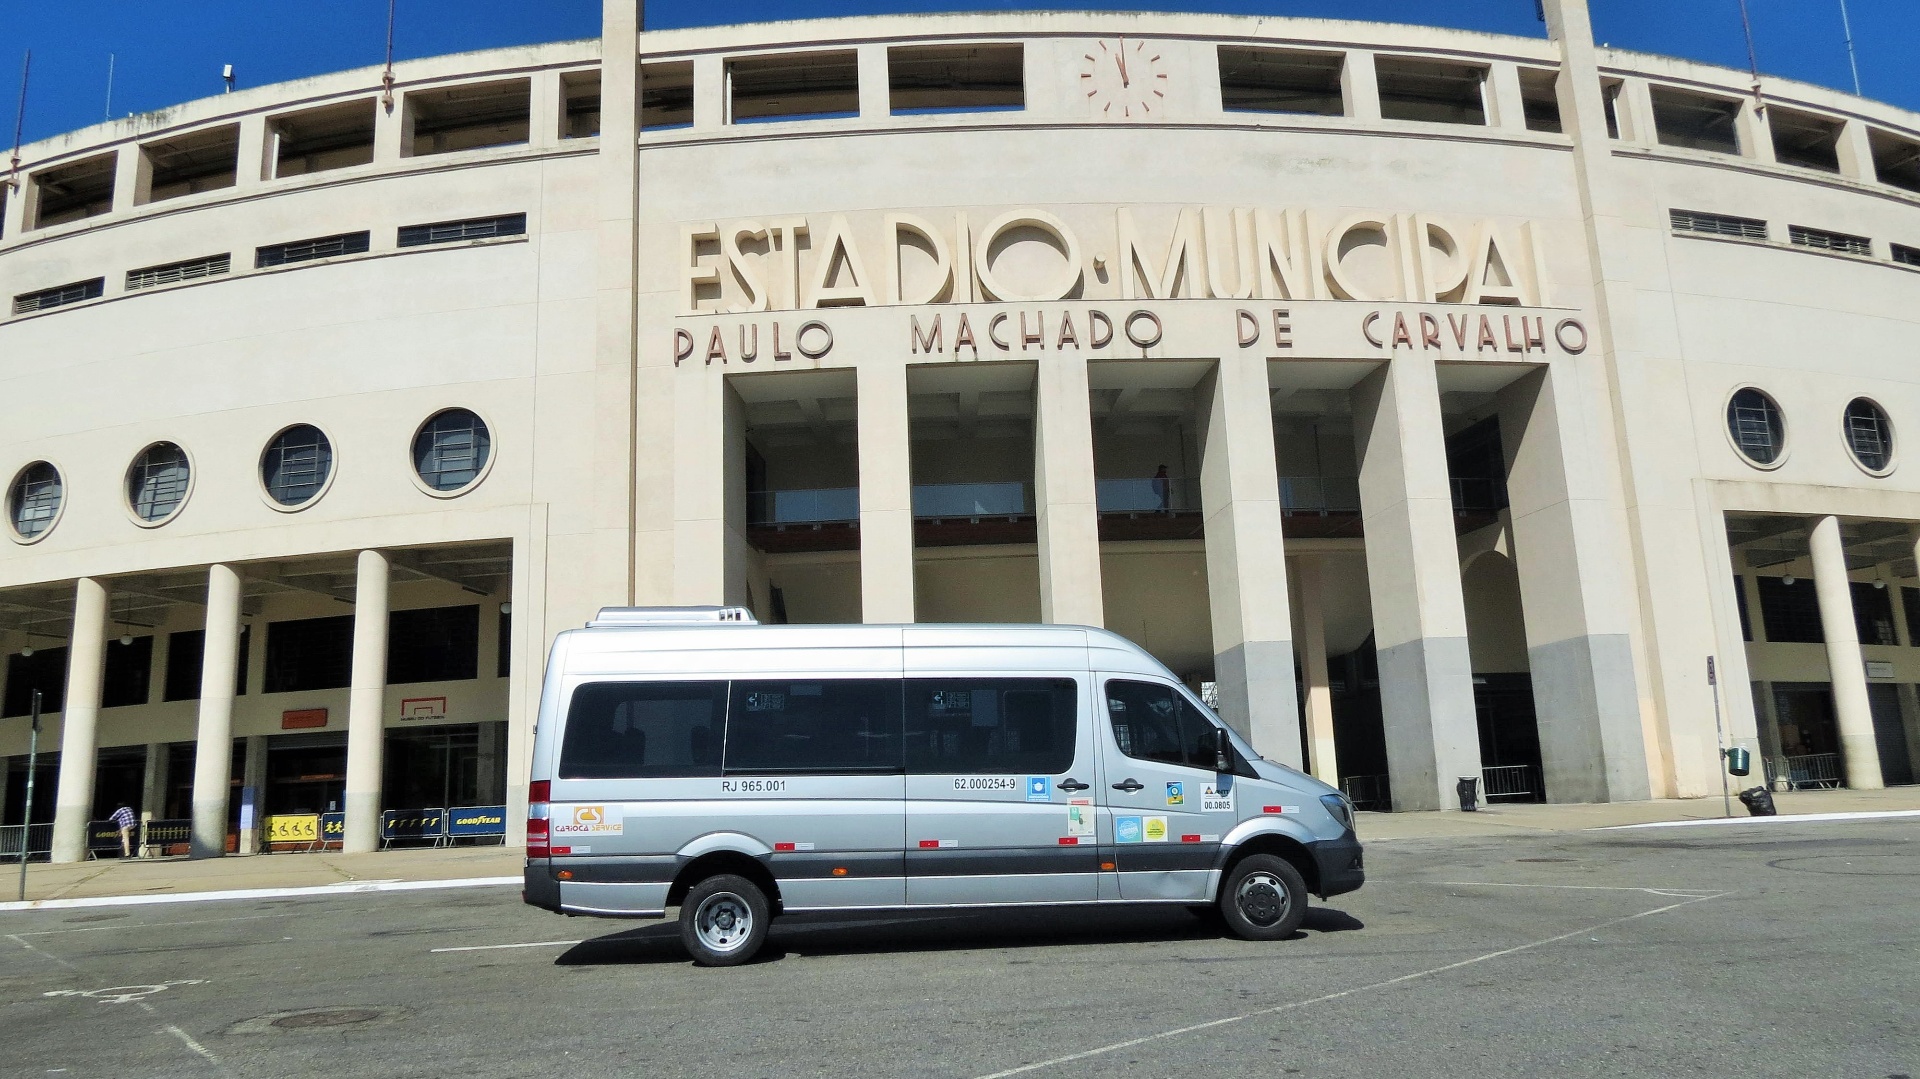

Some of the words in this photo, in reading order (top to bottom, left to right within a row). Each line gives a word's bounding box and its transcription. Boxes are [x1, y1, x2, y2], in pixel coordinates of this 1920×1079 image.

[1115, 206, 1552, 309] MUNICIPAL
[674, 319, 834, 366] PAULO
[911, 308, 1163, 354] MACHADO
[1236, 308, 1294, 349] DE
[1362, 310, 1588, 355] CARVALHO
[722, 781, 737, 792] RJ
[741, 780, 785, 792] 965.001
[954, 778, 1016, 790] 62.000254-9
[456, 815, 501, 826] GOODYEAR
